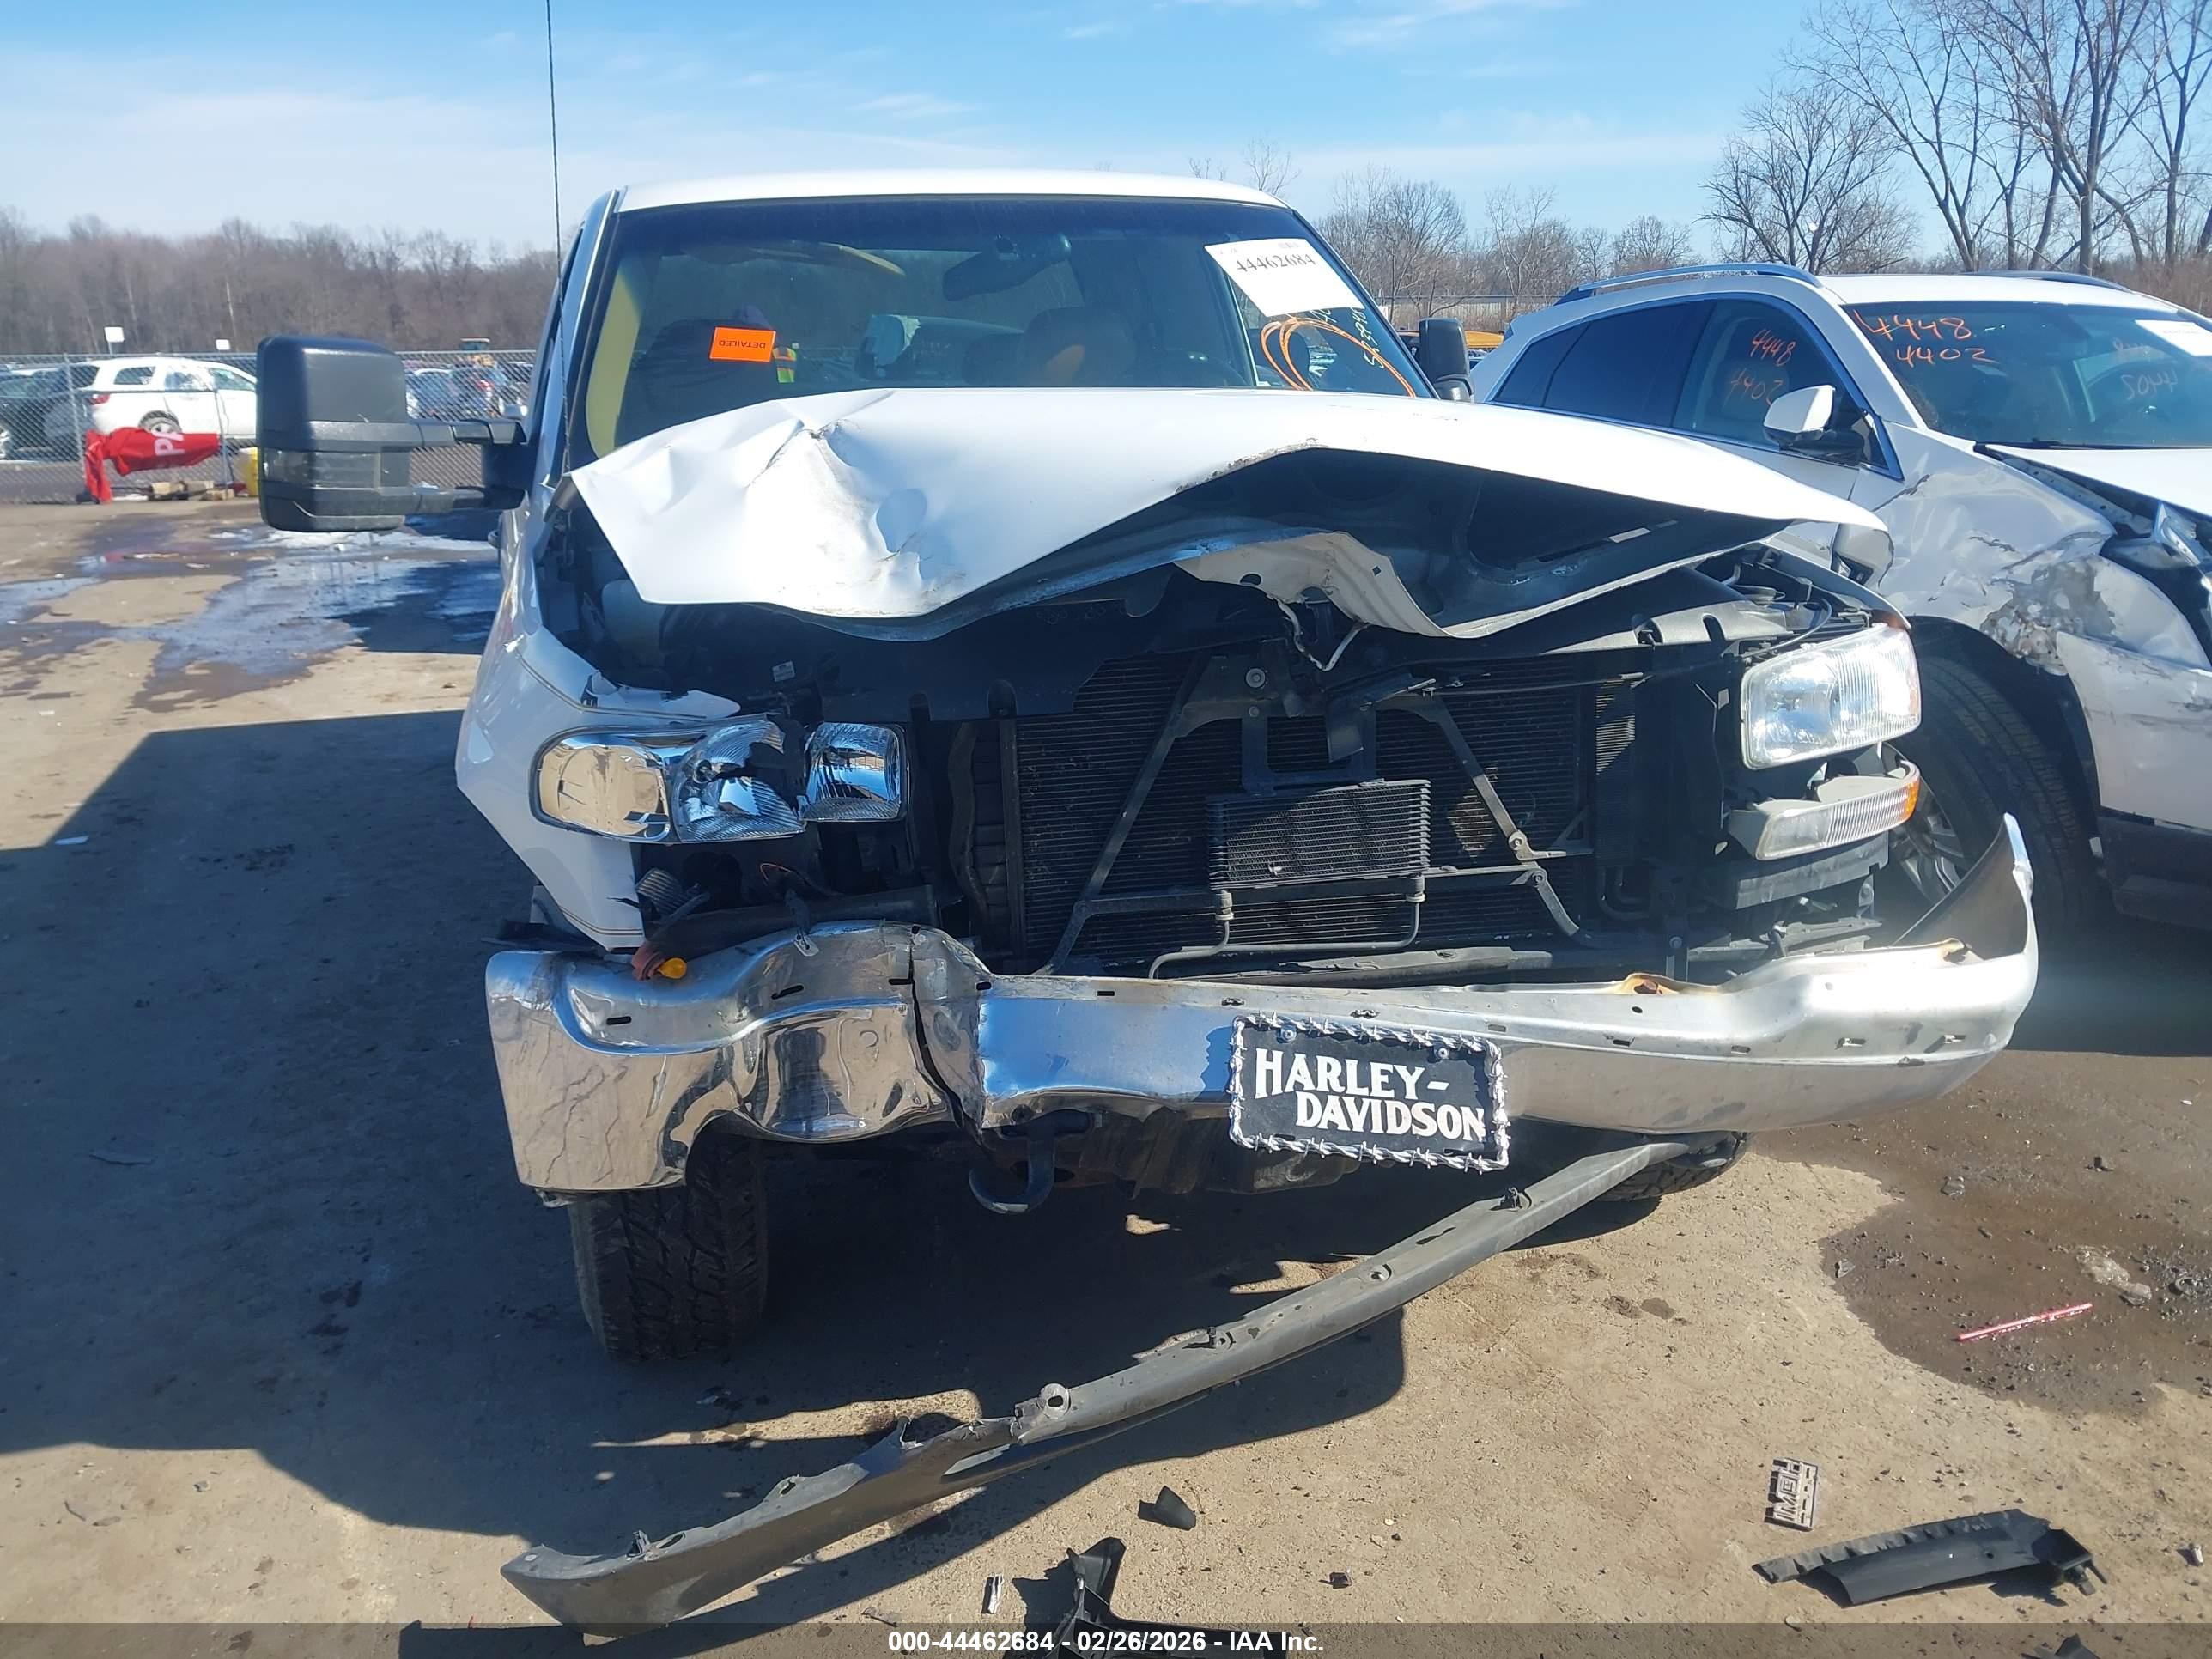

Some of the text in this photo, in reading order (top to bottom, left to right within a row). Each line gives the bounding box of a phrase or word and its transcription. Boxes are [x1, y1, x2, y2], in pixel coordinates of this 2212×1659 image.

[1236, 253, 1317, 273] 44462684
[1852, 309, 1972, 342] 4448
[719, 340, 766, 349] DETAILED
[1749, 328, 1796, 367] 4448
[1895, 344, 2001, 368] 4402
[1724, 368, 1784, 406] 4402
[1255, 1048, 1450, 1100] HARLEY-
[1295, 1091, 1486, 1143] DAVIDSON
